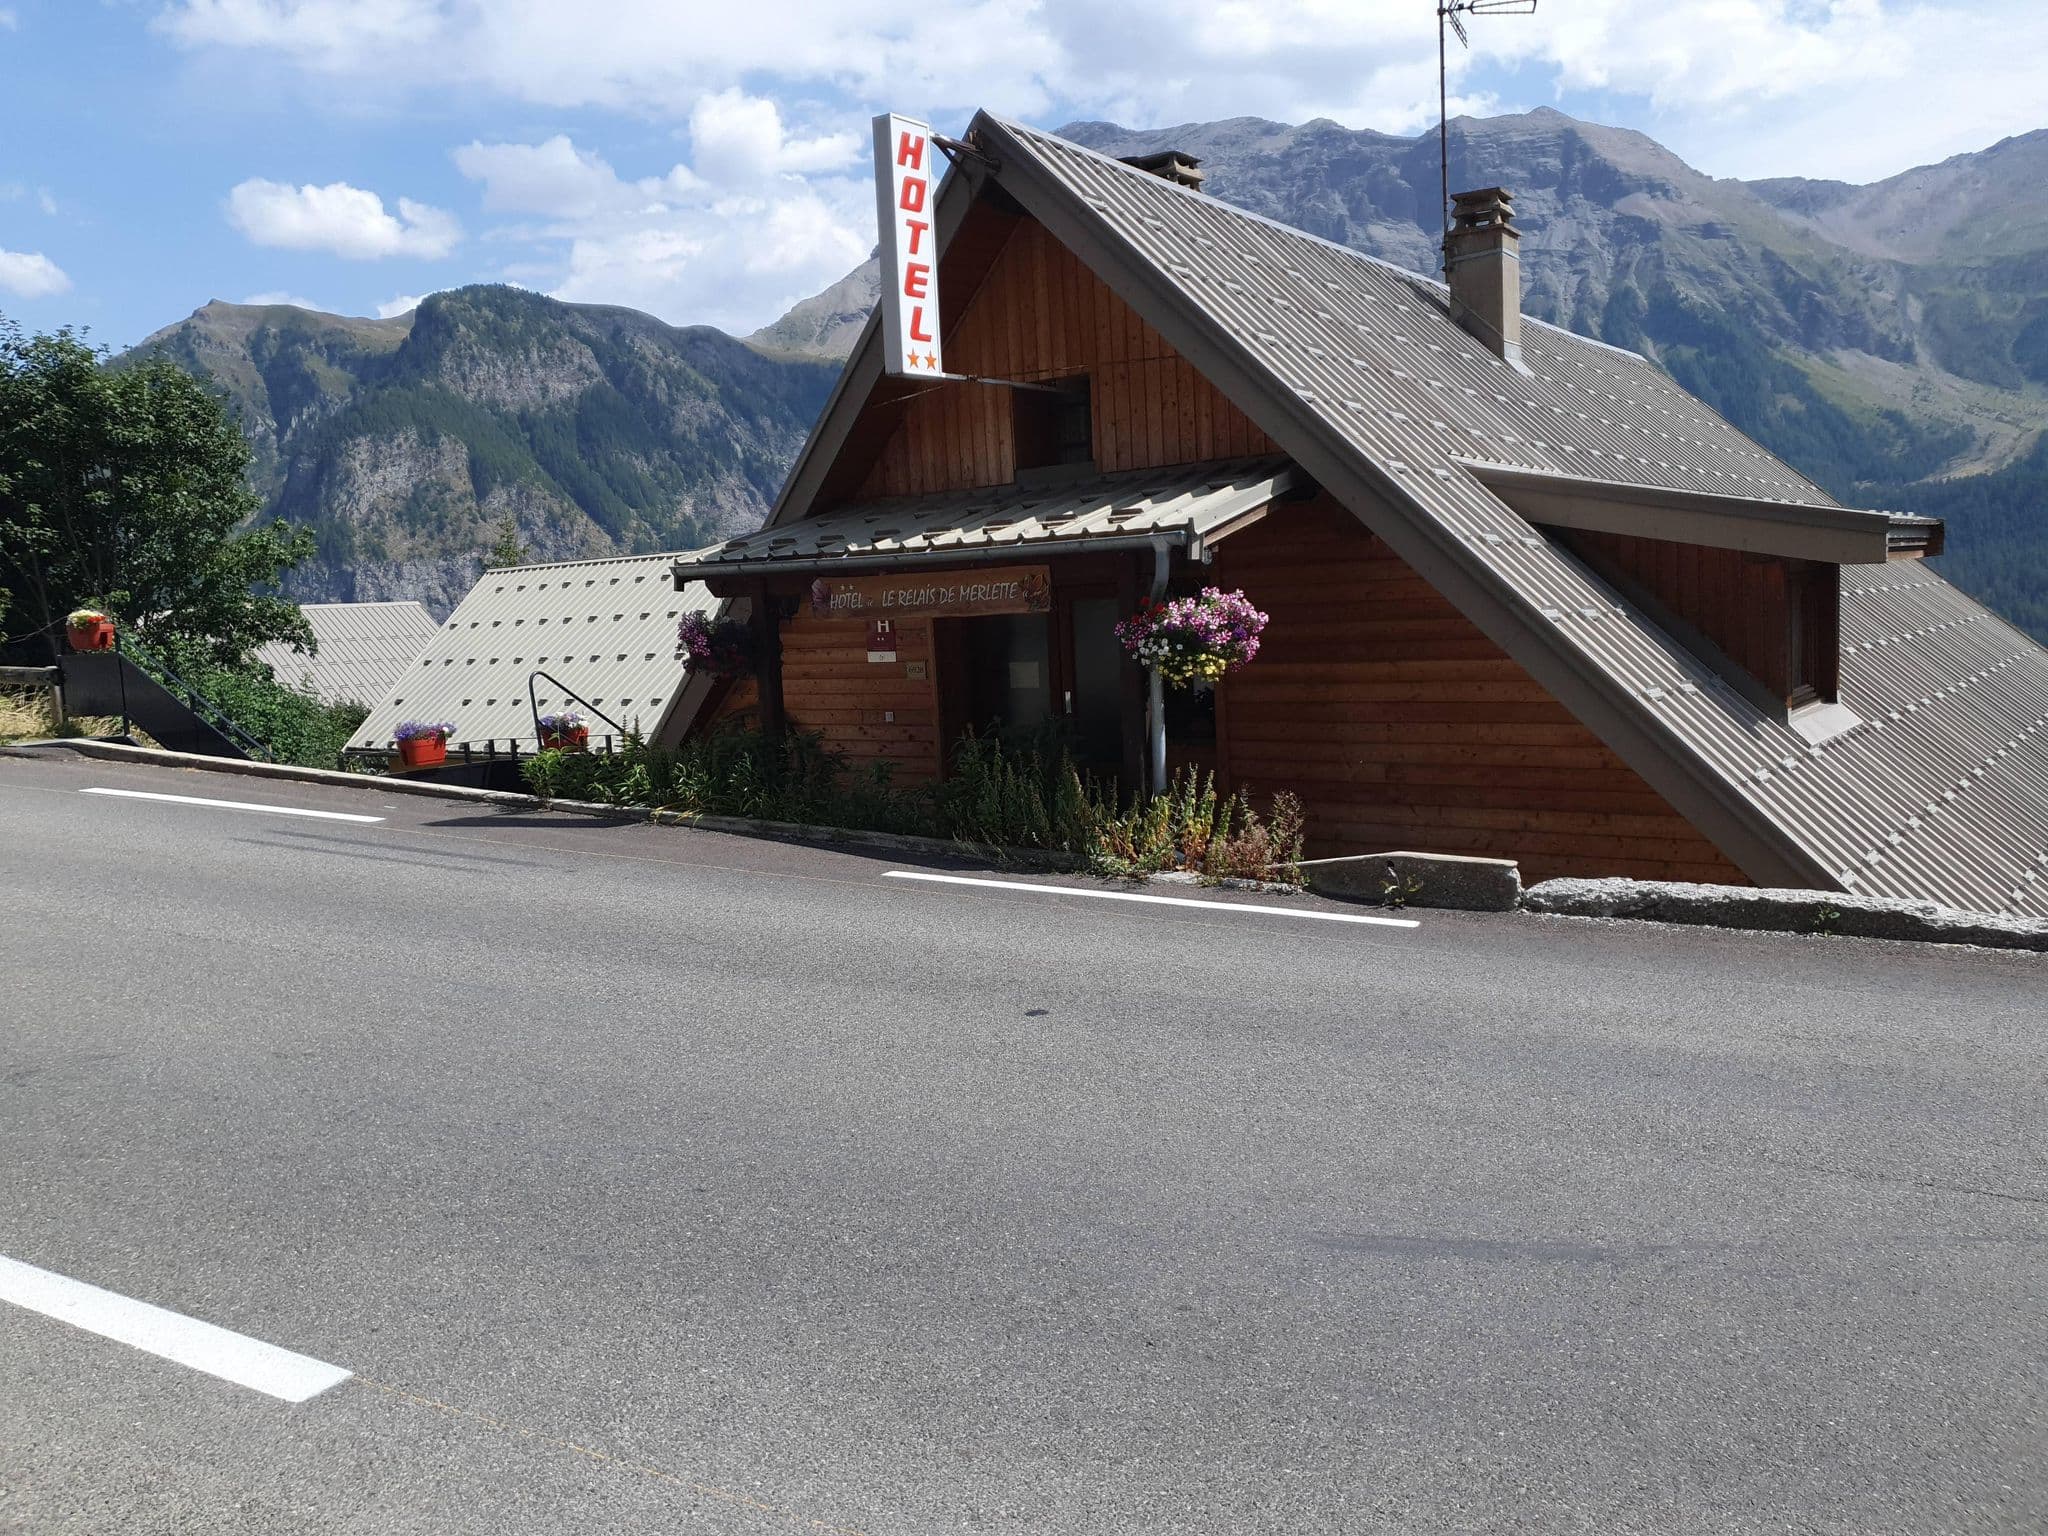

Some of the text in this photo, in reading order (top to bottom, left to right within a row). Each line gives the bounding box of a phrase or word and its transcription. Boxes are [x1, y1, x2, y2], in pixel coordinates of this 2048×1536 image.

[898, 133, 931, 342] HOTEL
[830, 592, 863, 609] HOTEL
[882, 590, 895, 607] LE
[939, 586, 956, 604] DE
[959, 582, 1018, 602] MERLETTE
[877, 620, 890, 633] H
